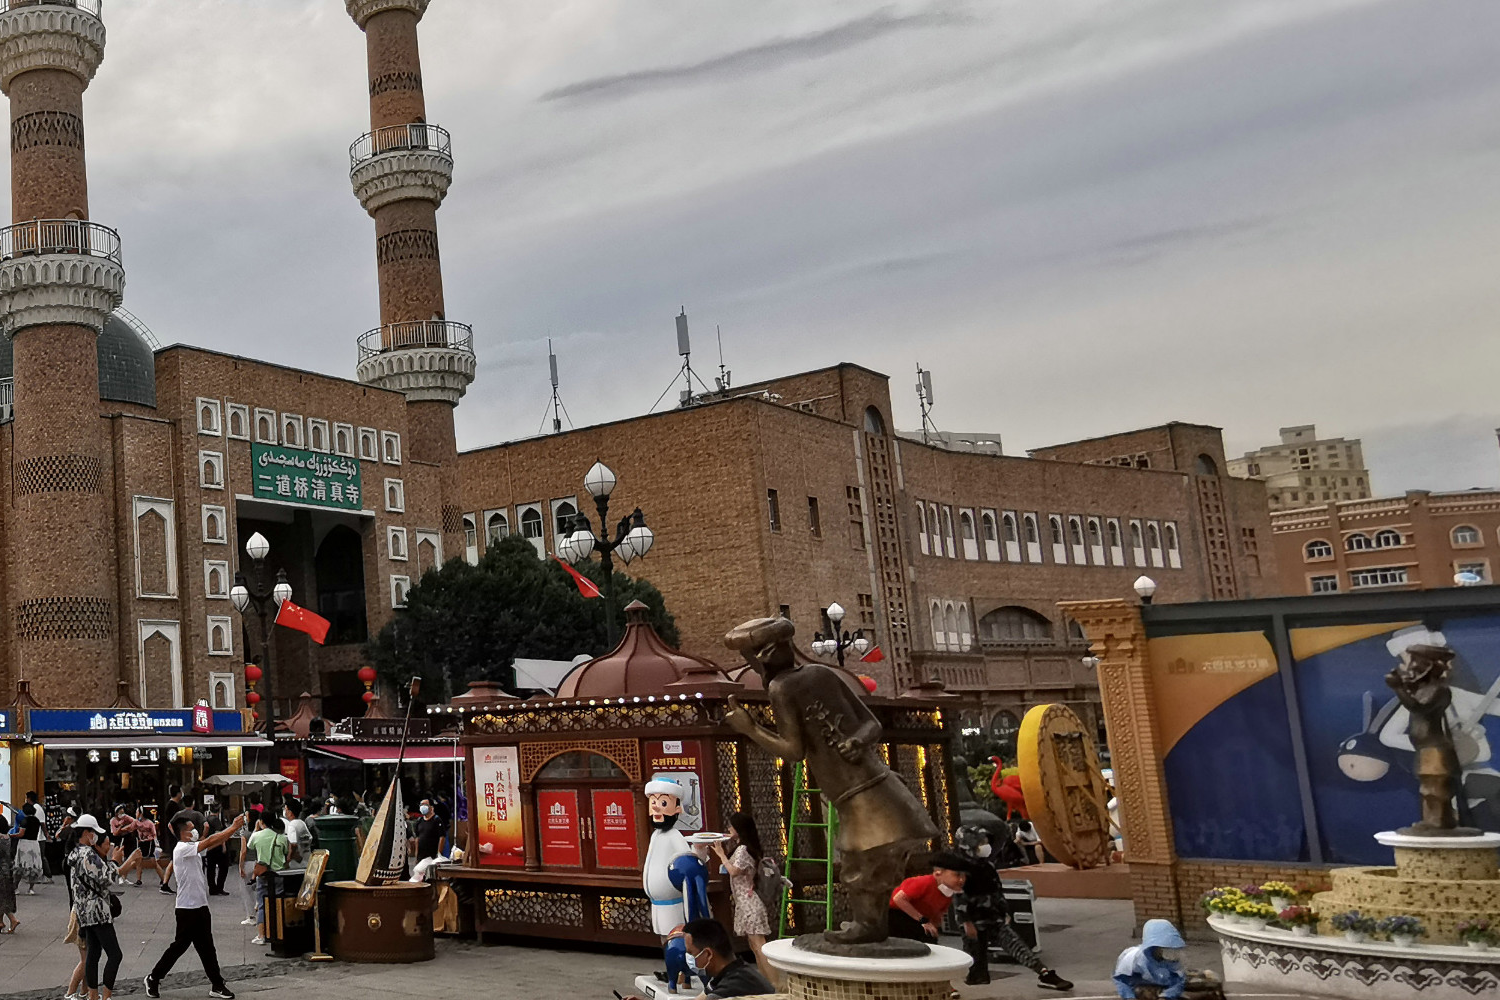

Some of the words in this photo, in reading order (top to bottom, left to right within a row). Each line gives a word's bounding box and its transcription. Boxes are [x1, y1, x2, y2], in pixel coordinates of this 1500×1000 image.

[258, 474, 360, 505] 二道桥清真寺
